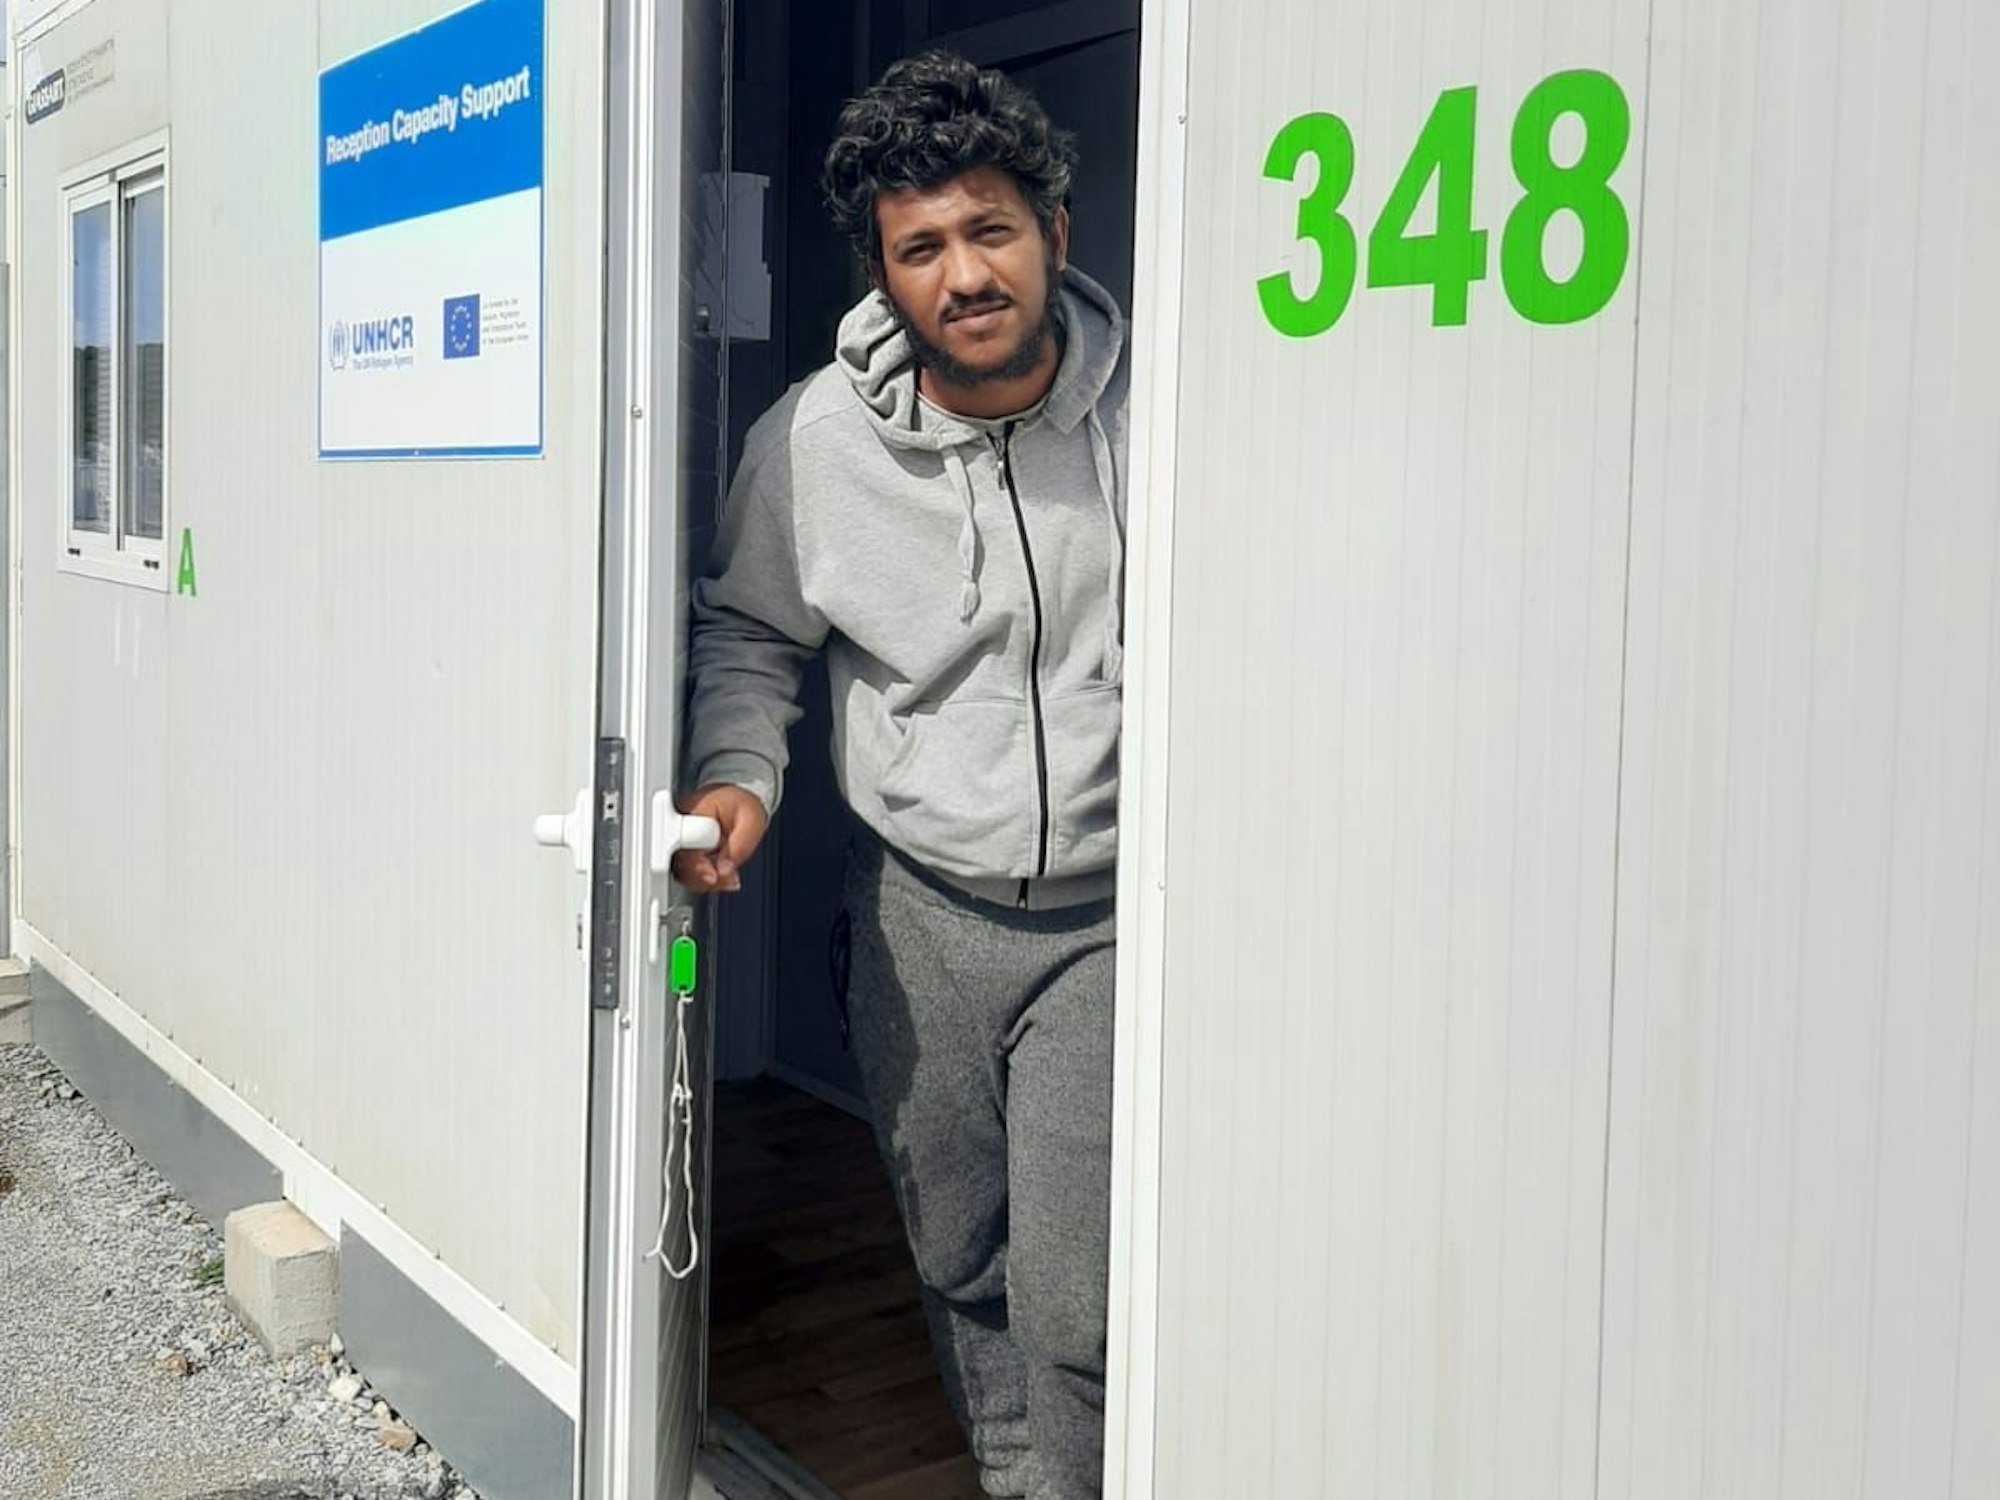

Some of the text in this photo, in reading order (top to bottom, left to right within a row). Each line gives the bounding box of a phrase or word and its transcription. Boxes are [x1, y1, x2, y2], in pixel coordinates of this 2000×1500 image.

[326, 65, 530, 165] Reception Capacity Support
[1257, 68, 1630, 337] 348
[352, 315, 414, 355] UNHCR
[178, 527, 196, 597] A
